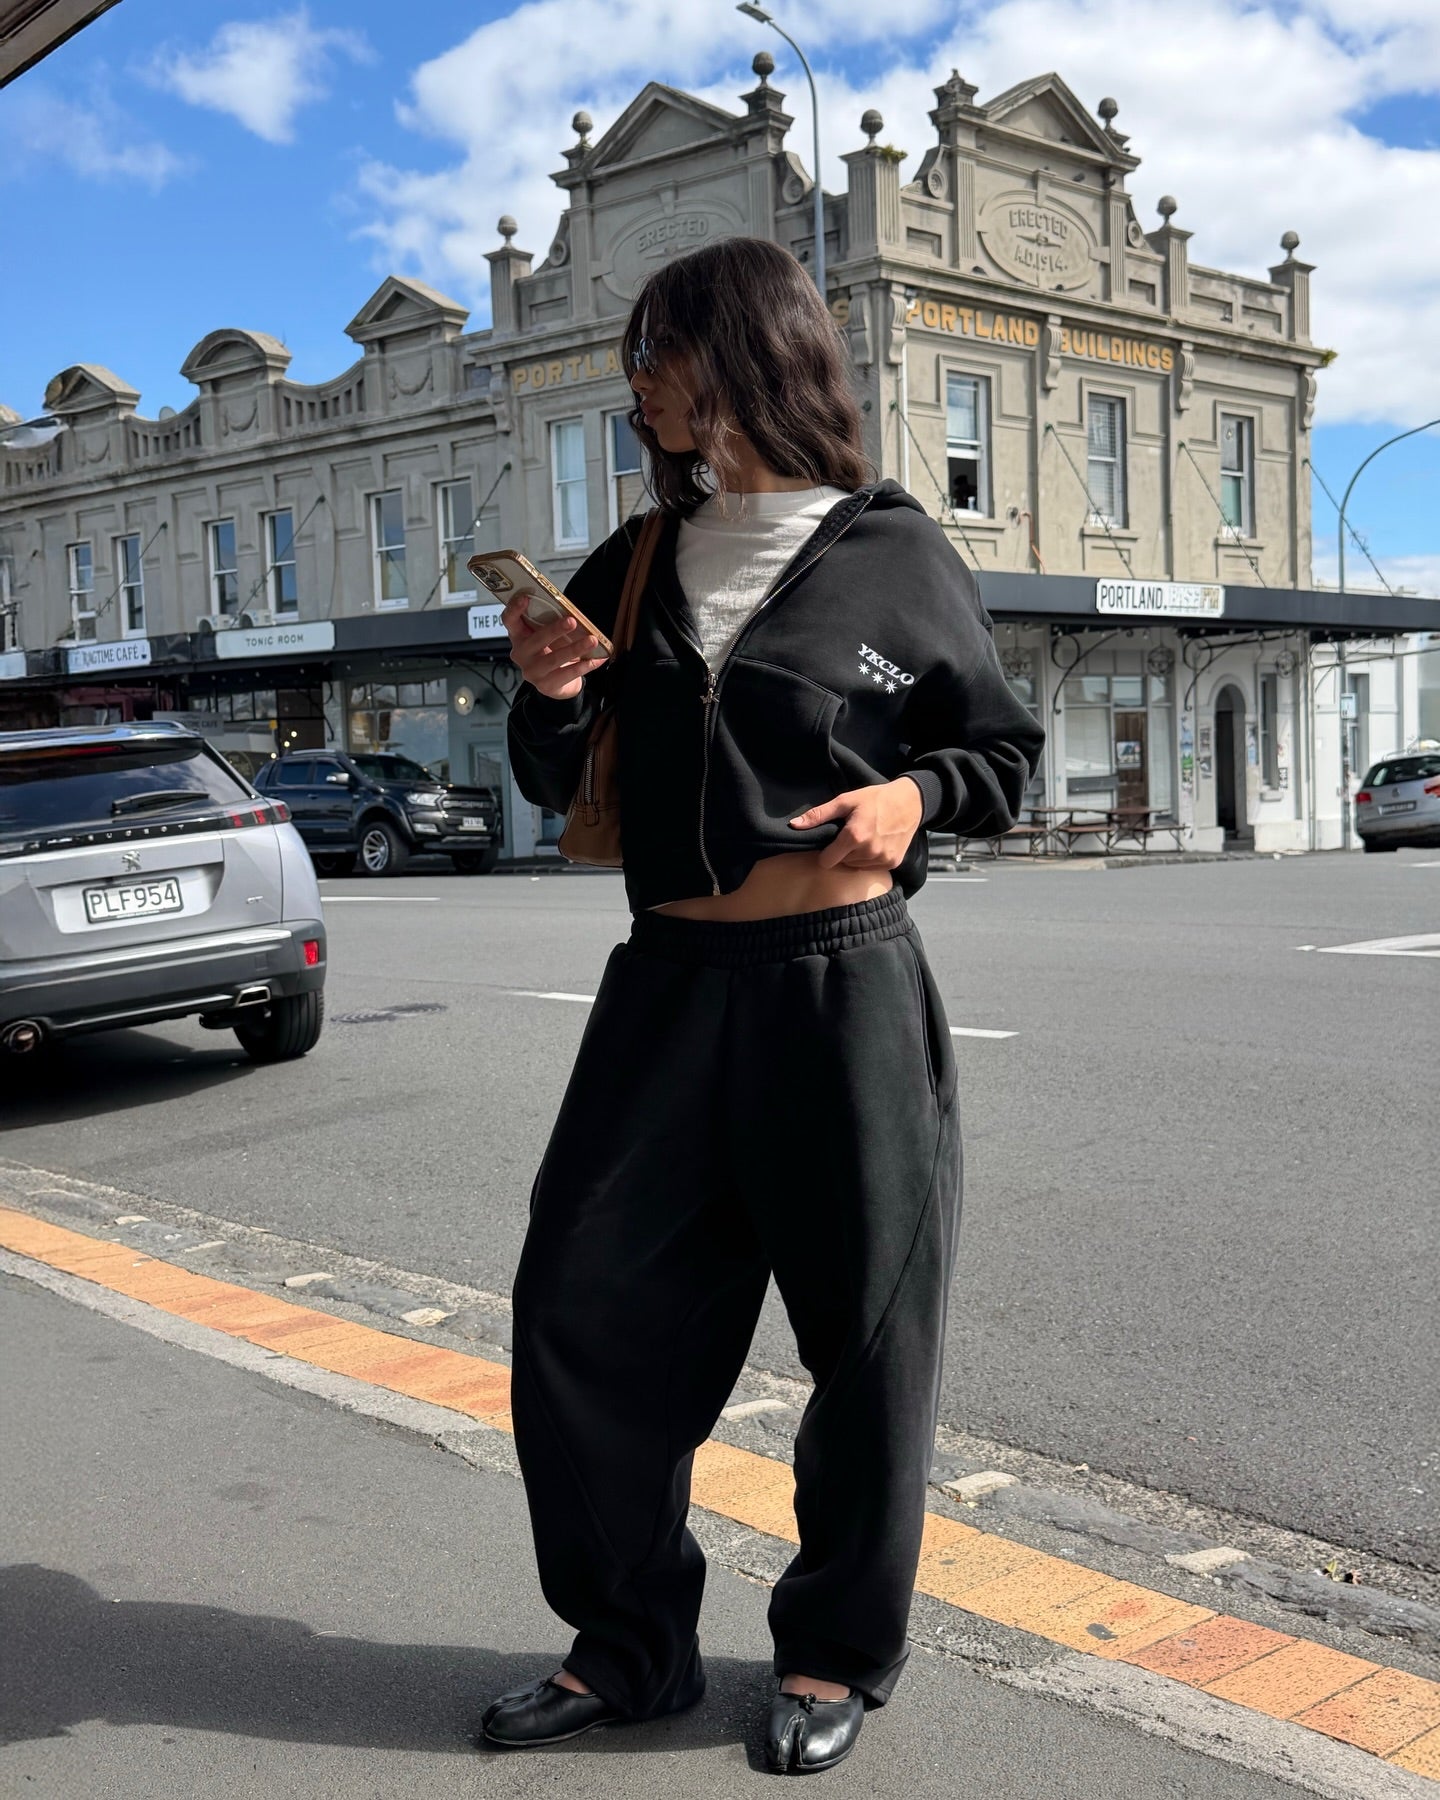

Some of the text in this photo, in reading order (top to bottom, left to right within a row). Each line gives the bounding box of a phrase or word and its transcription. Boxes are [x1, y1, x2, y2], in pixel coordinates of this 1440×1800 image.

[635, 218, 709, 253] ERECTED
[1008, 209, 1069, 240] ERECTED
[905, 298, 1174, 371] PORTLAND BUILDINGS
[512, 348, 624, 393] PORTLA
[473, 616, 490, 629] THE
[246, 634, 304, 647] TONIC ROOM
[858, 643, 915, 685] YKCLO
[89, 883, 177, 915] PLF954
